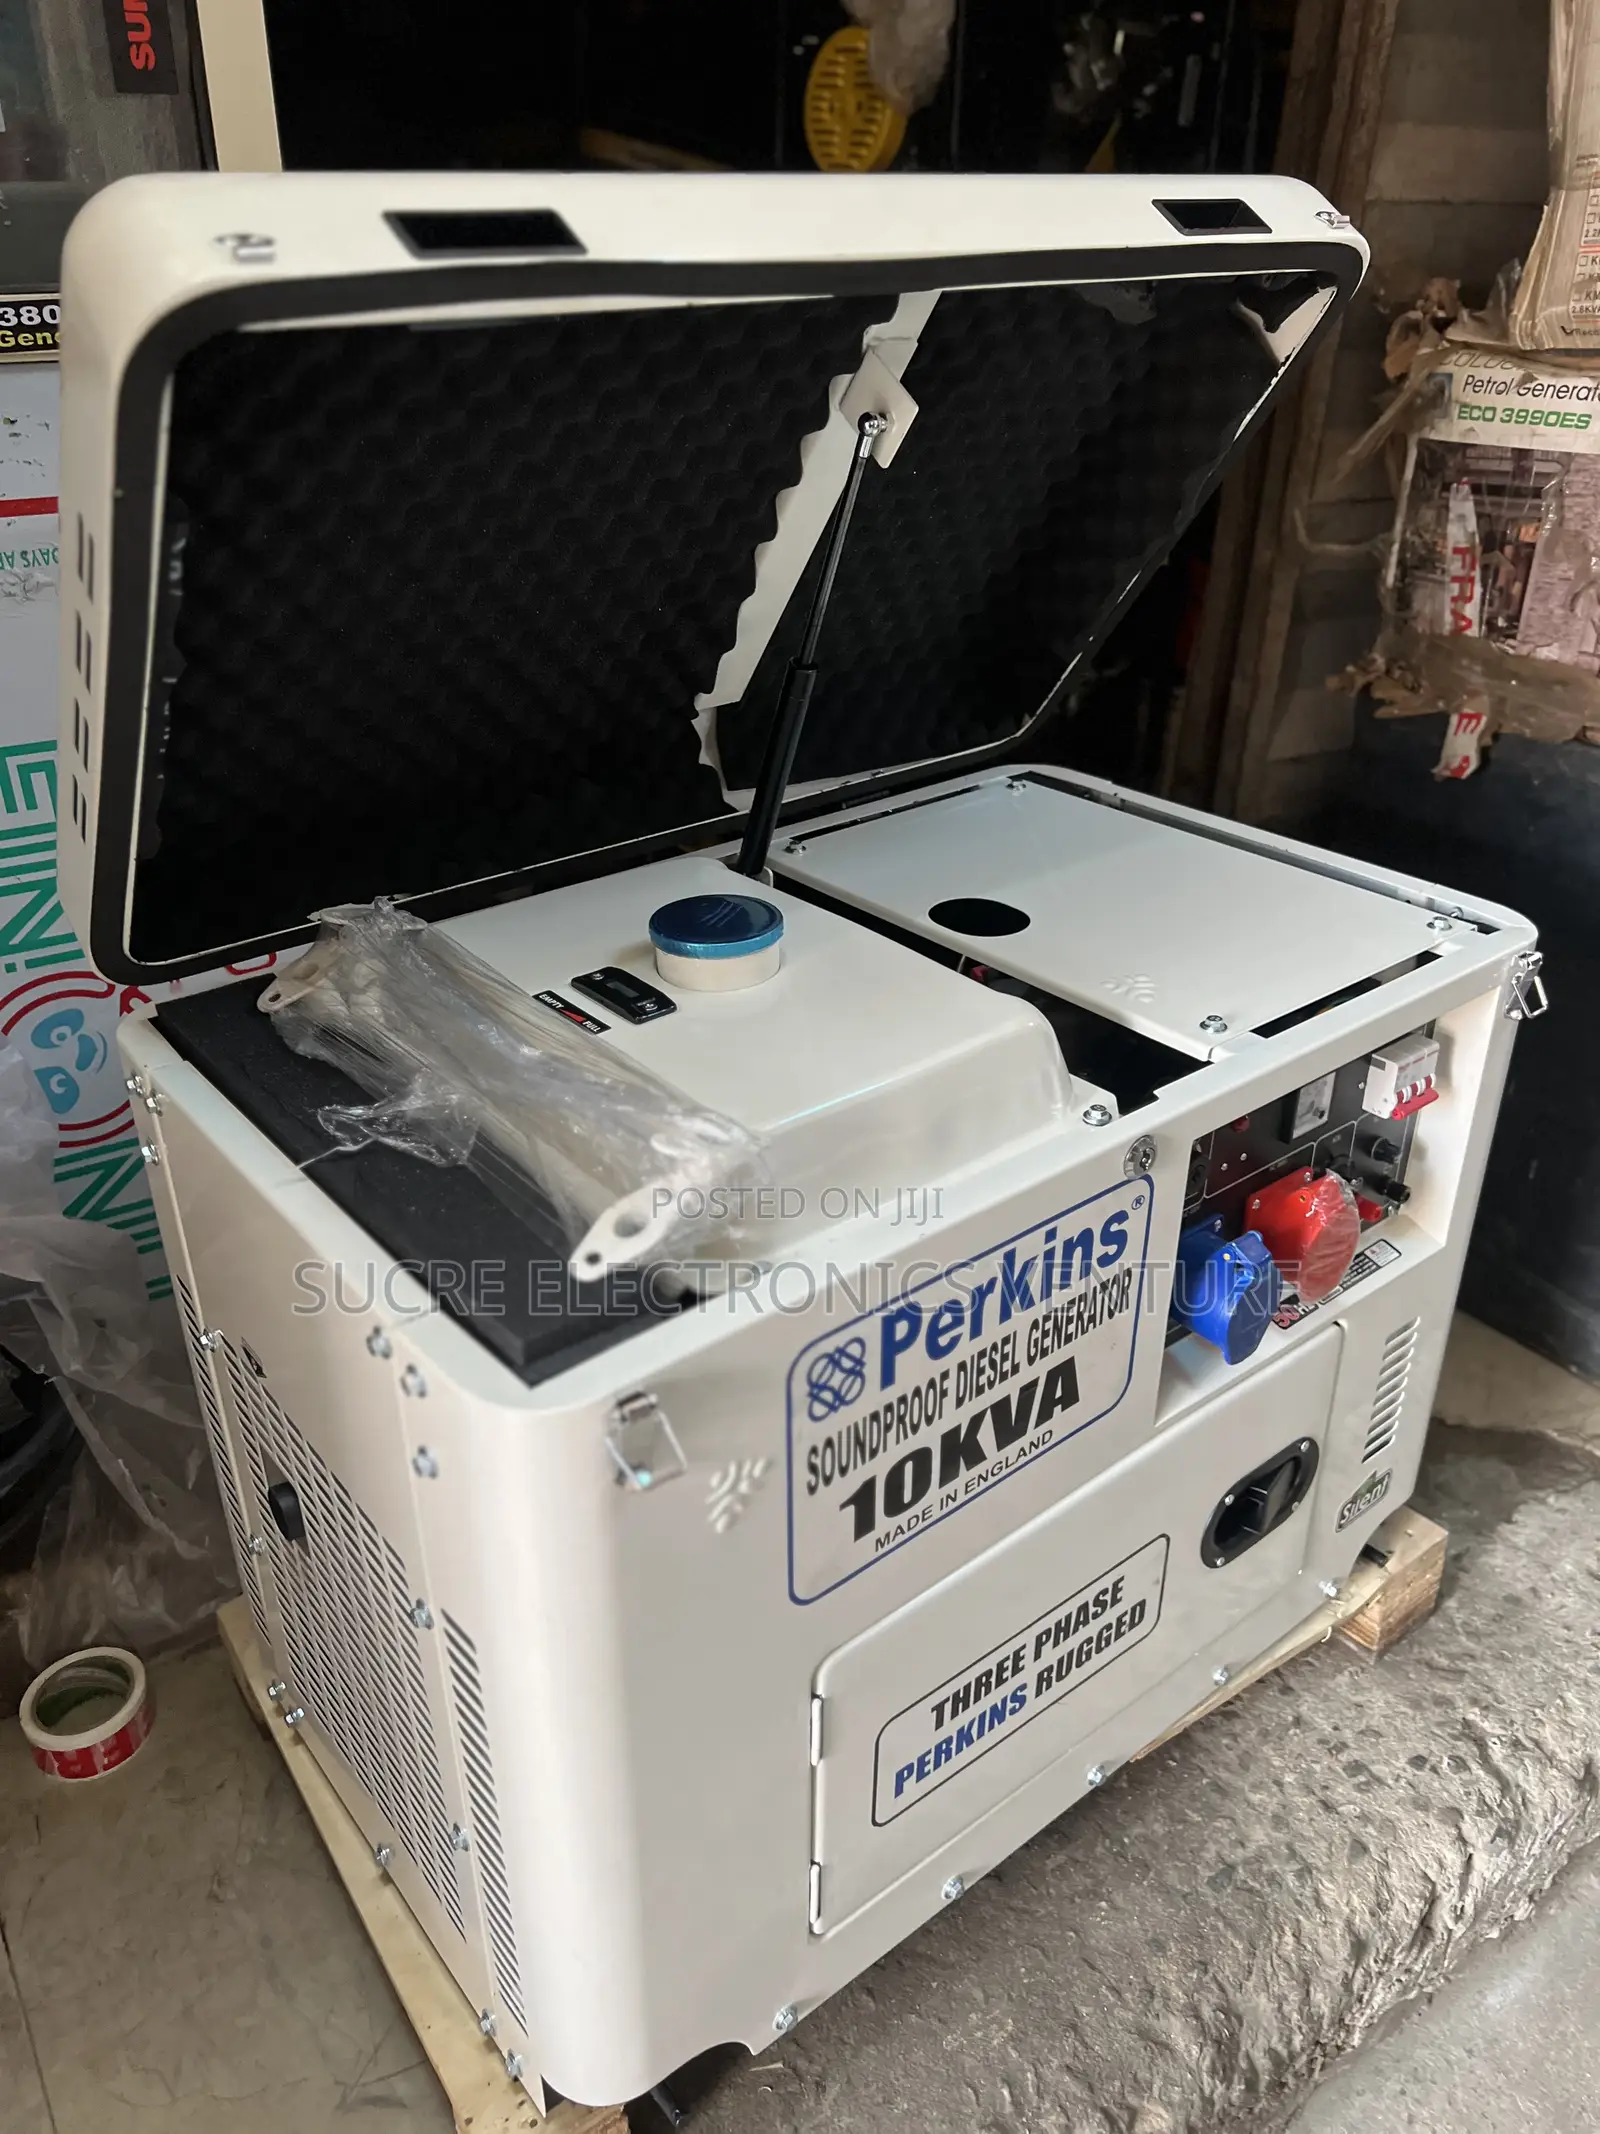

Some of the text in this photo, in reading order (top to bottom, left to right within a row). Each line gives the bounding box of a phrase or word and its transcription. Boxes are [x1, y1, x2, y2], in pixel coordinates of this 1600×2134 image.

[1458, 404, 1592, 430] ECO 3990ES
[1462, 374, 1514, 396] Petrol
[538, 993, 565, 1009] EMPTY
[582, 1019, 601, 1033] FULL
[807, 1267, 1133, 1496] SOUNDPROOF DIESEL GENERATOR
[839, 1356, 1080, 1543] 10KVA
[874, 1429, 1054, 1553] MADE IN ENGLAND
[894, 1598, 1147, 1799] PERKINS RUGGED
[931, 1575, 1125, 1732] THREE PHASE
